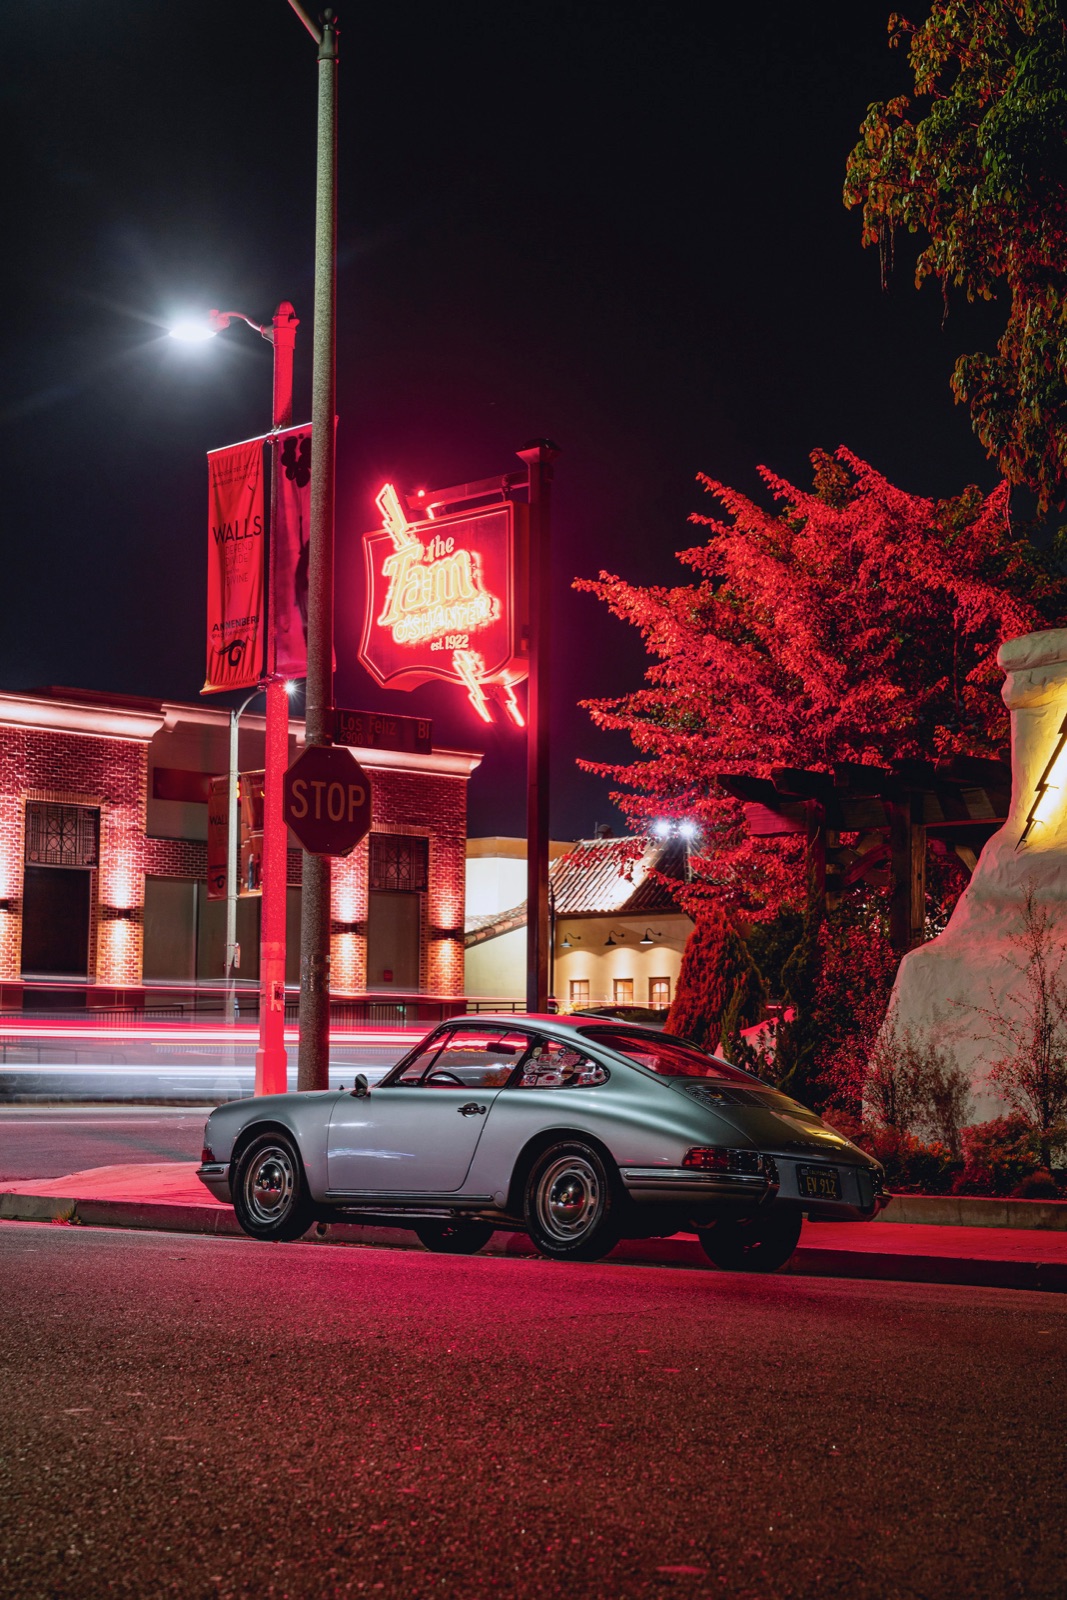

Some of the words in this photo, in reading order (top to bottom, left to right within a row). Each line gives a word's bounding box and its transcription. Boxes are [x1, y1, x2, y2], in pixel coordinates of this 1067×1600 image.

[212, 515, 262, 546] WALLS
[225, 541, 254, 556] DEFEND
[424, 534, 455, 562] the
[377, 543, 480, 626] Tam
[445, 634, 469, 650] 1922
[341, 712, 362, 731] Los
[369, 716, 397, 736] Feliz
[340, 730, 363, 745] 2900
[290, 779, 366, 822] STOP
[806, 1176, 817, 1192] EV
[820, 1178, 836, 1194] 912
